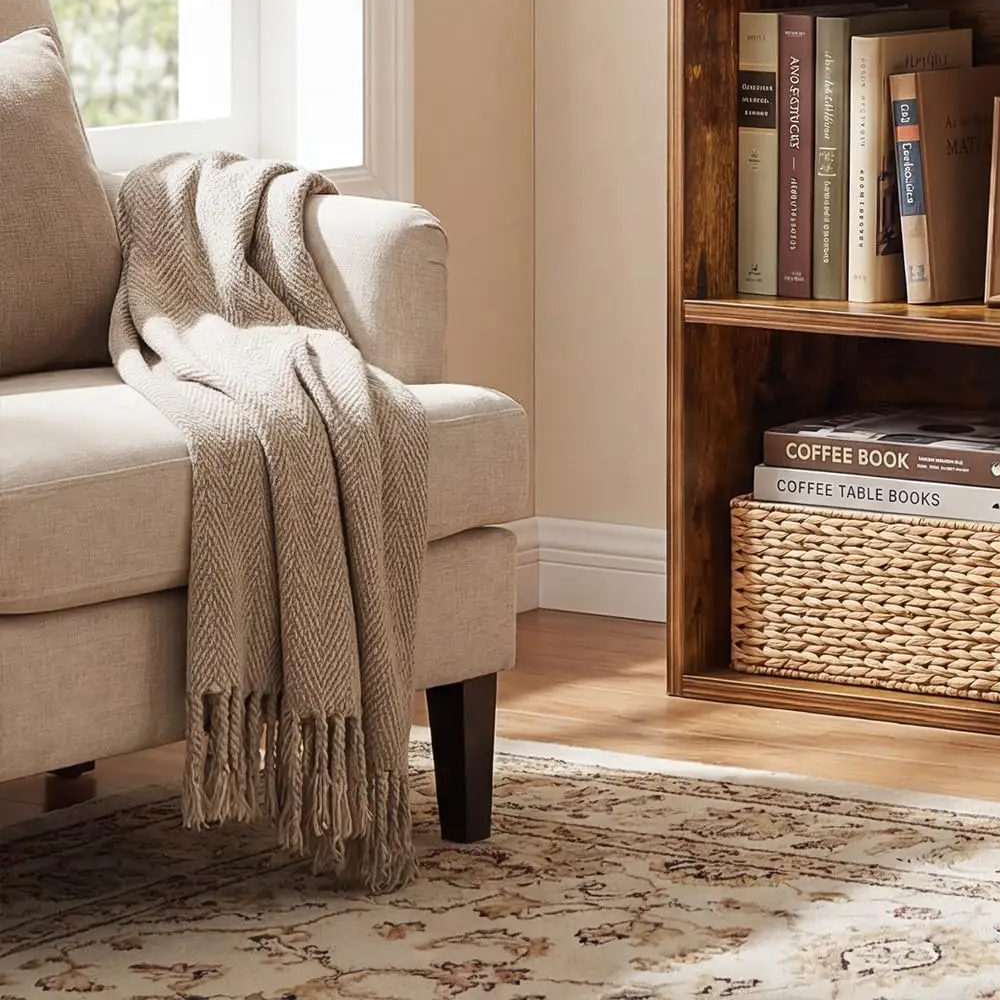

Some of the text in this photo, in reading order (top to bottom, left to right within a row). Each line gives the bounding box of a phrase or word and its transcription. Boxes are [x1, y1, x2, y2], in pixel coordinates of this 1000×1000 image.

[785, 442, 853, 464] COFFEE
[858, 449, 910, 470] BOOK
[776, 479, 941, 507] COFFEE TABLE BOOKS
